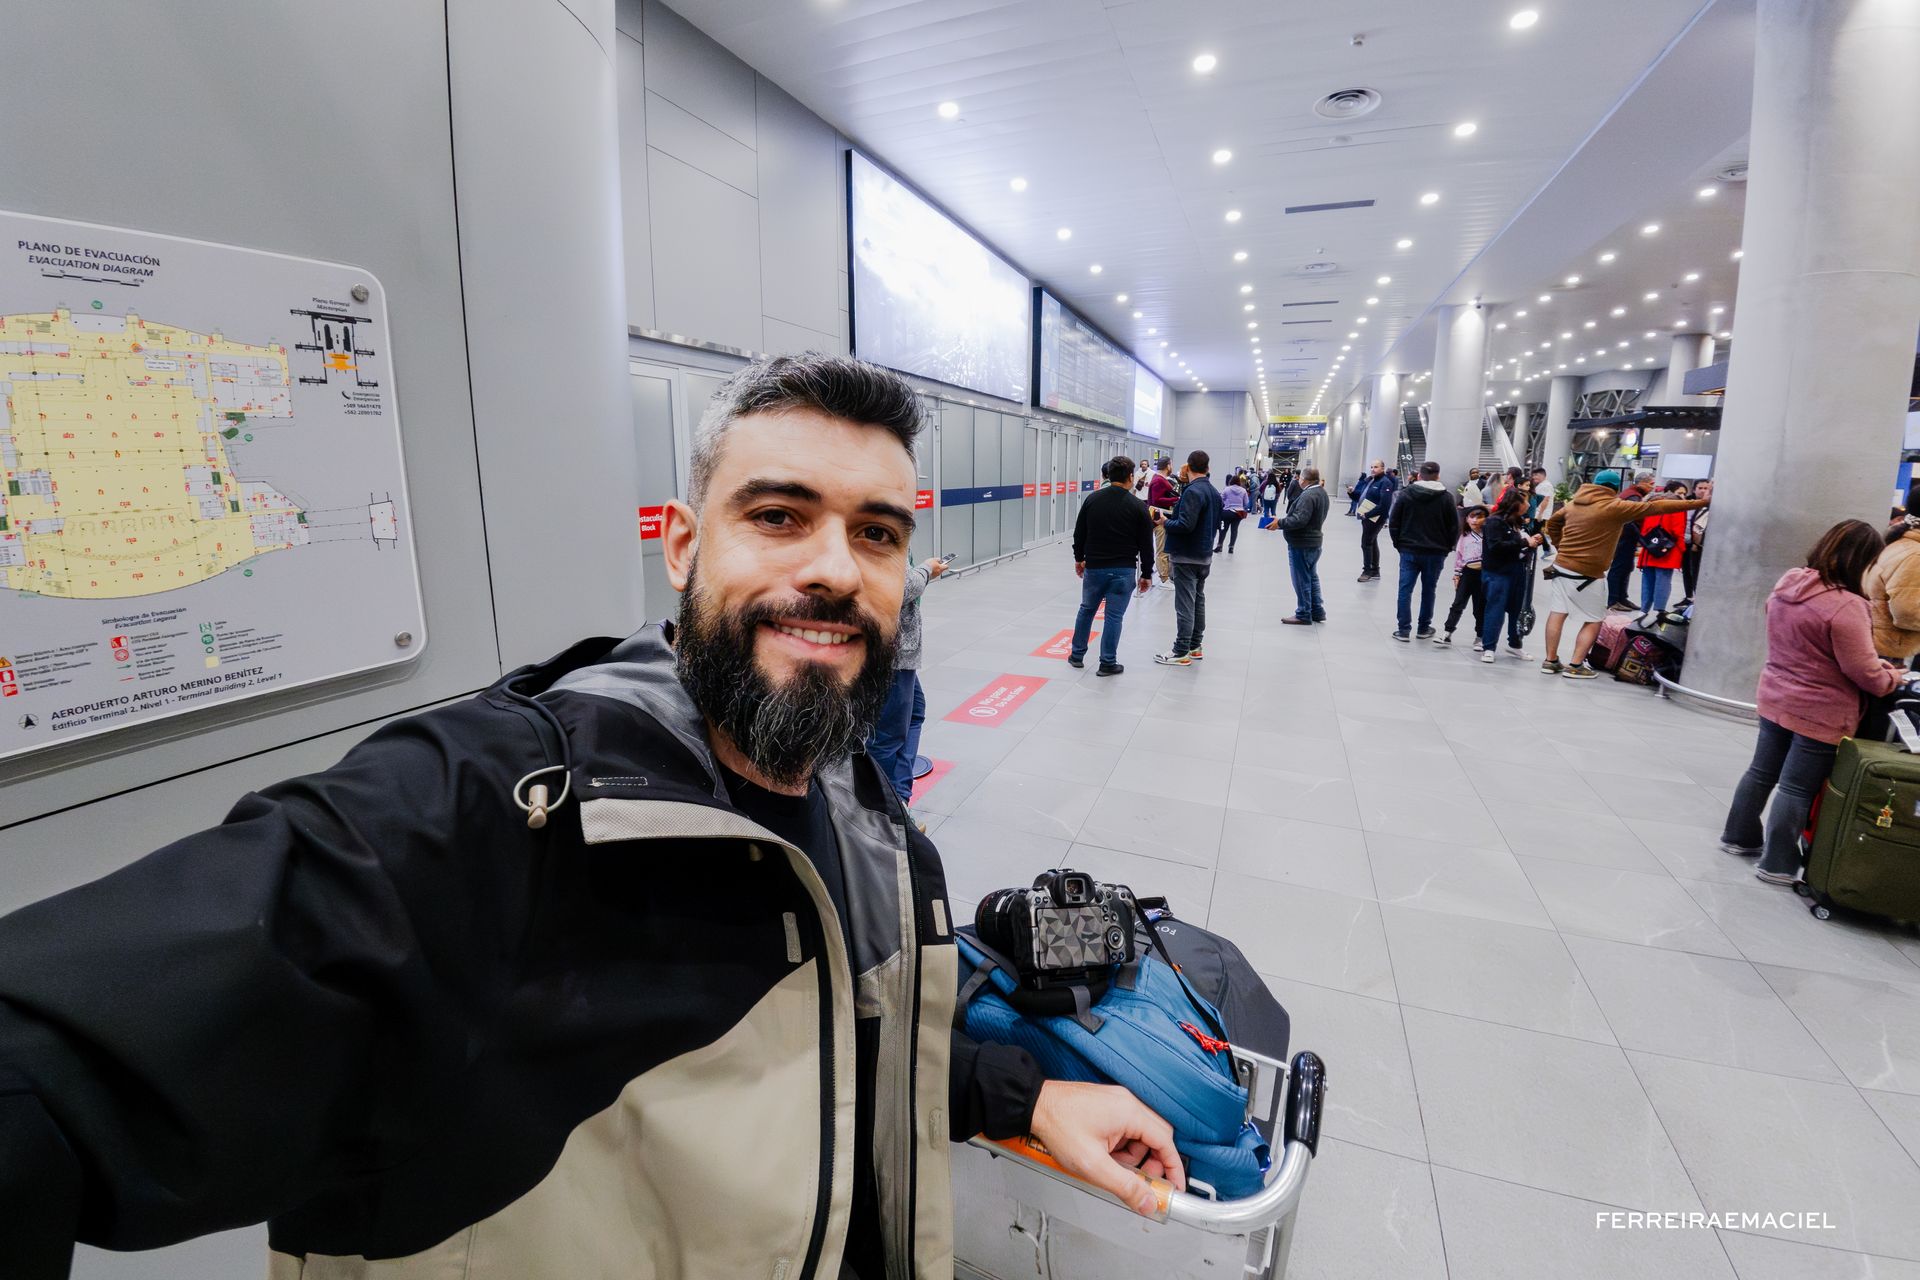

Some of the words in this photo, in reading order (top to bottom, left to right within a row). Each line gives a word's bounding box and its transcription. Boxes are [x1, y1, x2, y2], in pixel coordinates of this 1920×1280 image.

[18, 240, 61, 254] PLANO
[65, 246, 80, 257] DE
[85, 248, 160, 267] EVACUACIÓN
[28, 254, 100, 271] EVACUATION
[102, 263, 154, 277] DIAGRAM
[51, 696, 129, 720] AEROPUERTO
[132, 685, 178, 703] ARTURO
[180, 675, 222, 691] MERINO
[224, 666, 264, 681] BENÍTEZ
[51, 718, 87, 731] Edificio
[89, 708, 128, 722] Terminal
[140, 700, 162, 711] Nivel
[177, 689, 213, 701] Terminal
[214, 682, 246, 694] Building
[257, 673, 276, 684] Level
